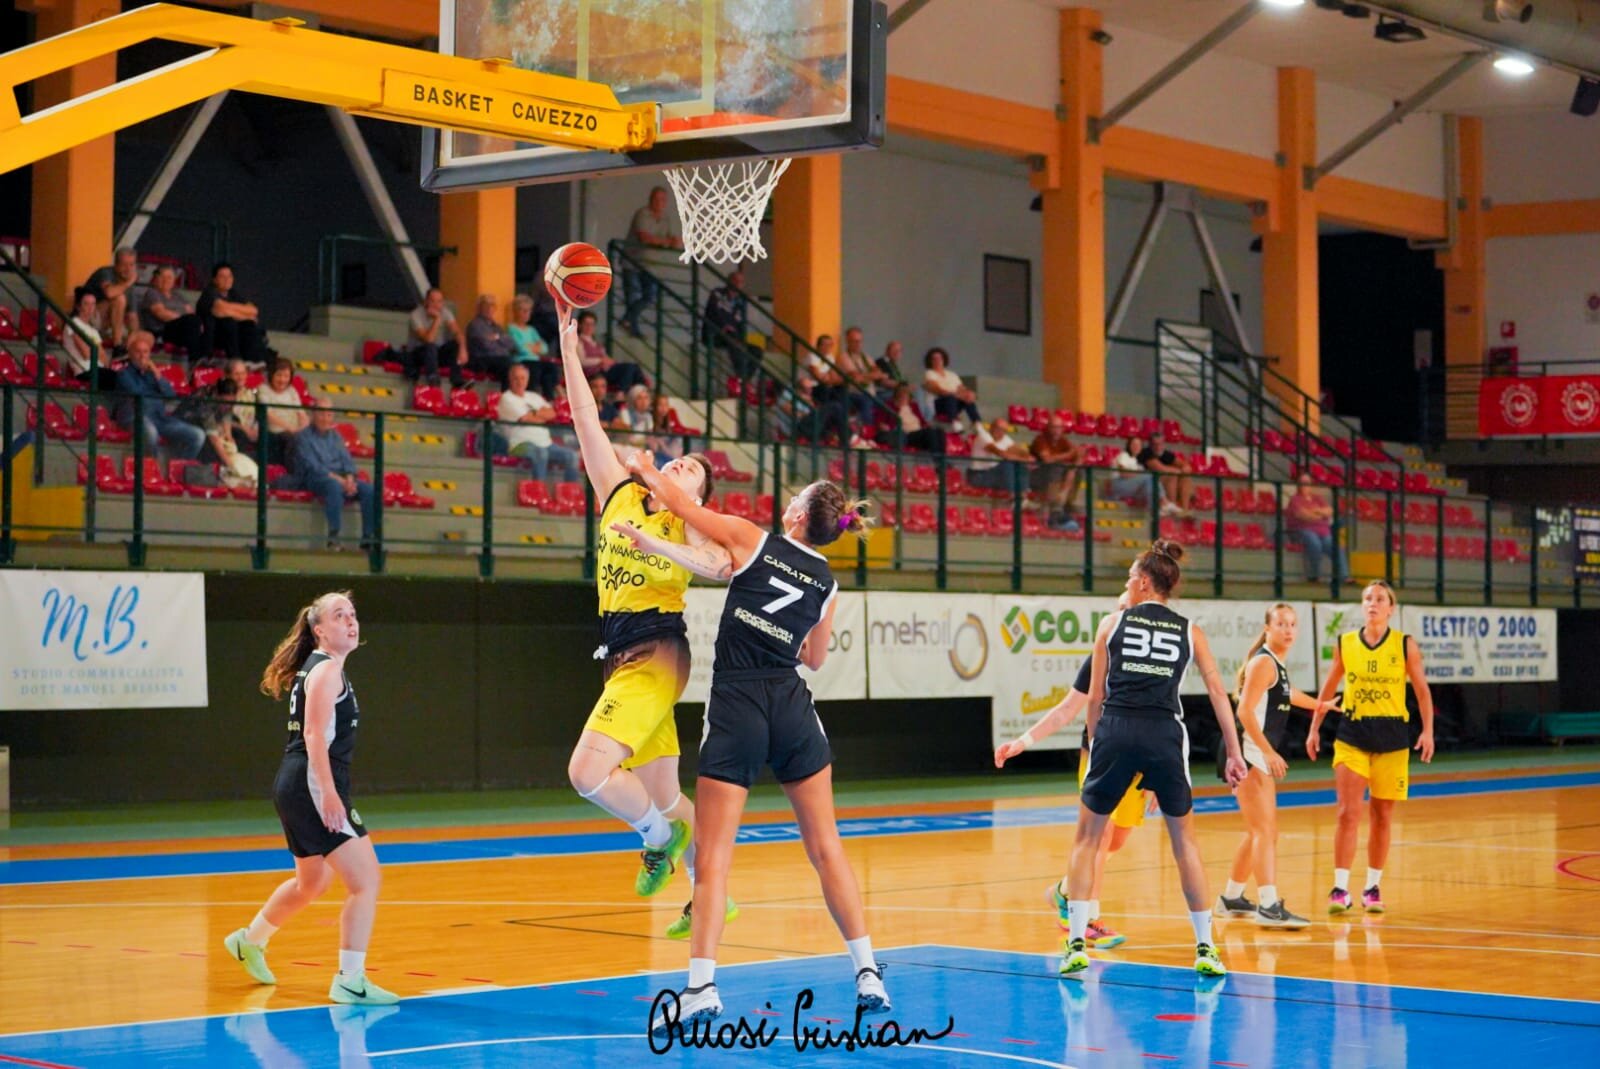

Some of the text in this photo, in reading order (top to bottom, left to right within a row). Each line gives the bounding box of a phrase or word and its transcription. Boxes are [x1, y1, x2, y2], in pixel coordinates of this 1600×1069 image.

[413, 84, 598, 131] BASKET CAVEZZO
[609, 543, 672, 572] WAMGROUP
[761, 576, 806, 615] 7
[41, 585, 150, 662] M.B.
[869, 607, 952, 645] mekoil
[1422, 615, 1537, 638] ELETTRO 2000
[1121, 626, 1182, 663] 35
[1367, 660, 1378, 673] 18
